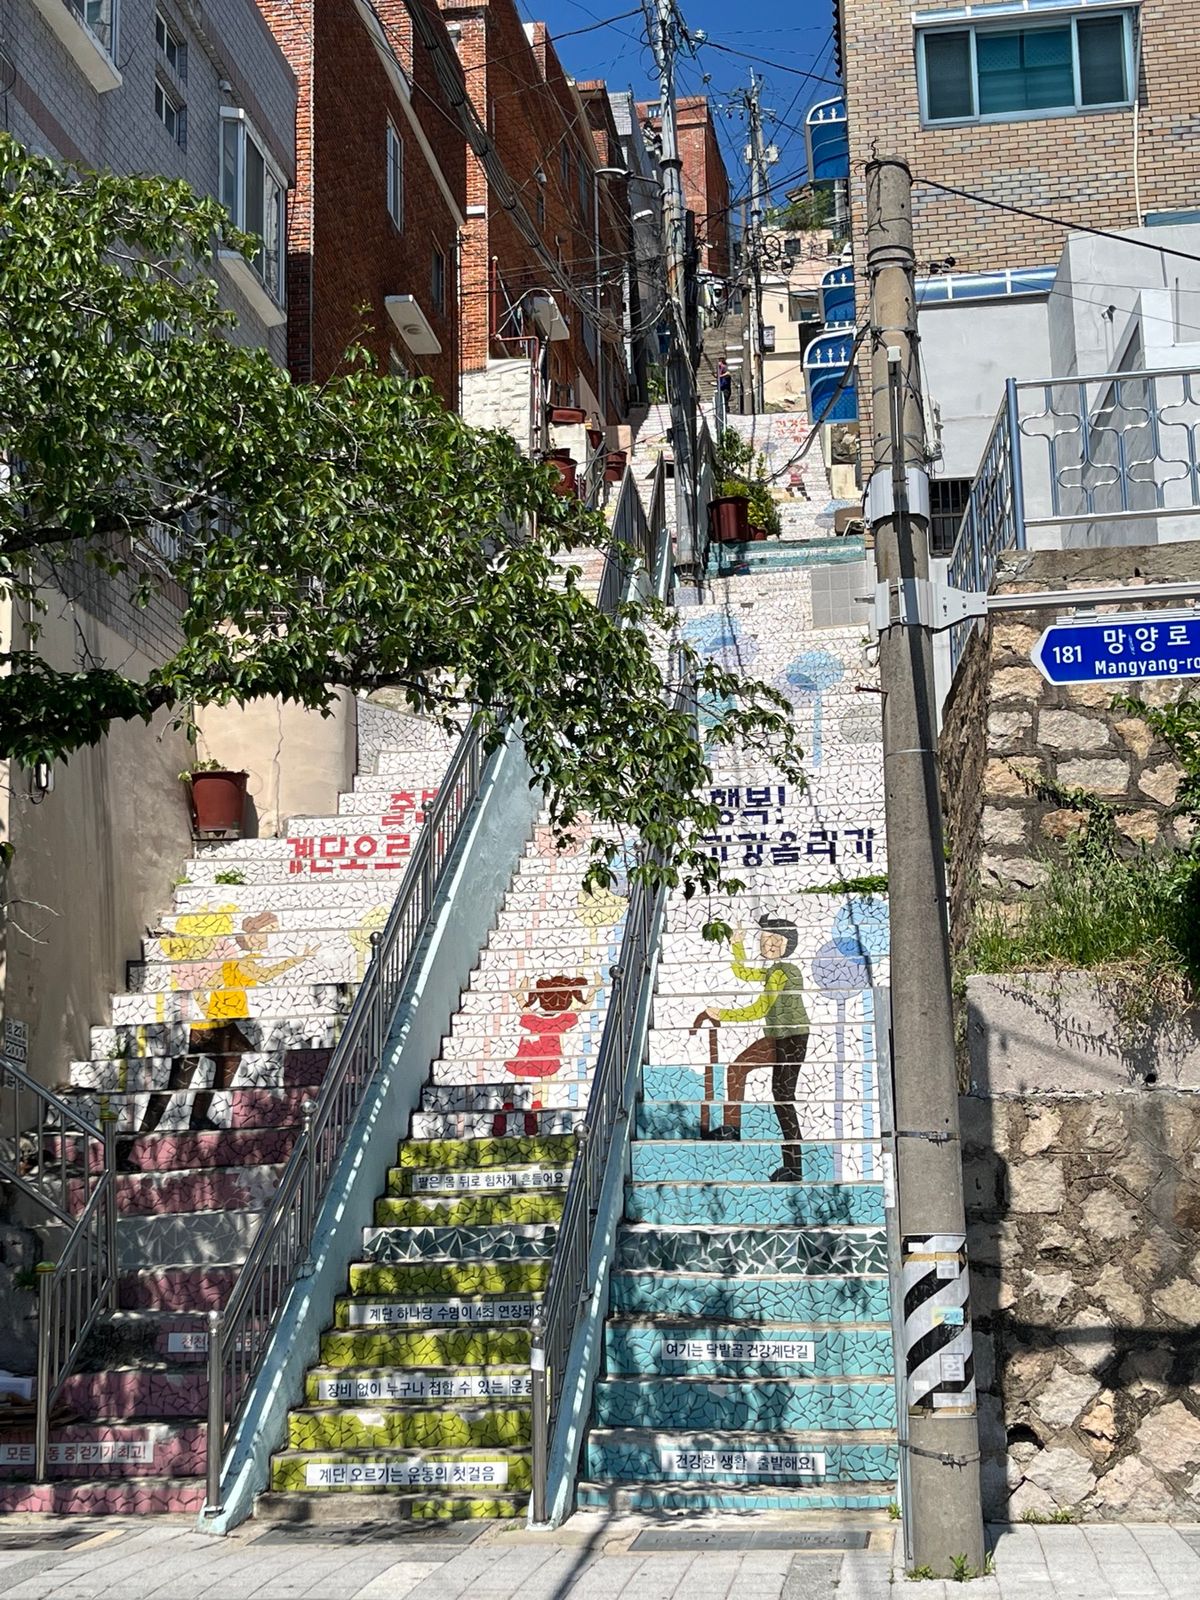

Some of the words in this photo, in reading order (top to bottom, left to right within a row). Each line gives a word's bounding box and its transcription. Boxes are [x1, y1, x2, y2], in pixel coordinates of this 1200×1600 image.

[1103, 625, 1191, 654] 망양로
[1052, 645, 1082, 663] 181
[1095, 656, 1200, 676] Mangyang-ro
[710, 786, 785, 825] 행복!
[287, 832, 444, 873] 계단오르
[418, 1175, 440, 1188] 팔은
[460, 1174, 481, 1187] 뒤로
[485, 1174, 516, 1187] 힘차게
[521, 1172, 564, 1185] 흔들어요
[370, 1308, 392, 1321] 계단
[397, 1307, 433, 1320] 하나당
[438, 1306, 472, 1320] 수명이
[476, 1305, 493, 1319] 4초
[666, 1343, 703, 1357] 여기는
[747, 1344, 808, 1359] 건강계단길
[328, 1383, 351, 1397] 장비
[357, 1382, 381, 1397] 없이
[387, 1382, 425, 1396] 누구나
[429, 1381, 454, 1395] 접할
[460, 1381, 472, 1395] 수
[478, 1380, 503, 1395] 있는
[6, 1447, 32, 1461] 모든
[64, 1447, 76, 1461] 중
[80, 1446, 114, 1460] 걷기가
[118, 1444, 146, 1459] 최고!
[676, 1454, 716, 1470] 건강한
[720, 1454, 747, 1470] 생활
[757, 1455, 815, 1471] 출발해요!
[320, 1468, 345, 1483] 계단
[350, 1467, 403, 1483] 오르기는
[408, 1466, 447, 1483] 운동의
[453, 1466, 495, 1482] 첫걸음
